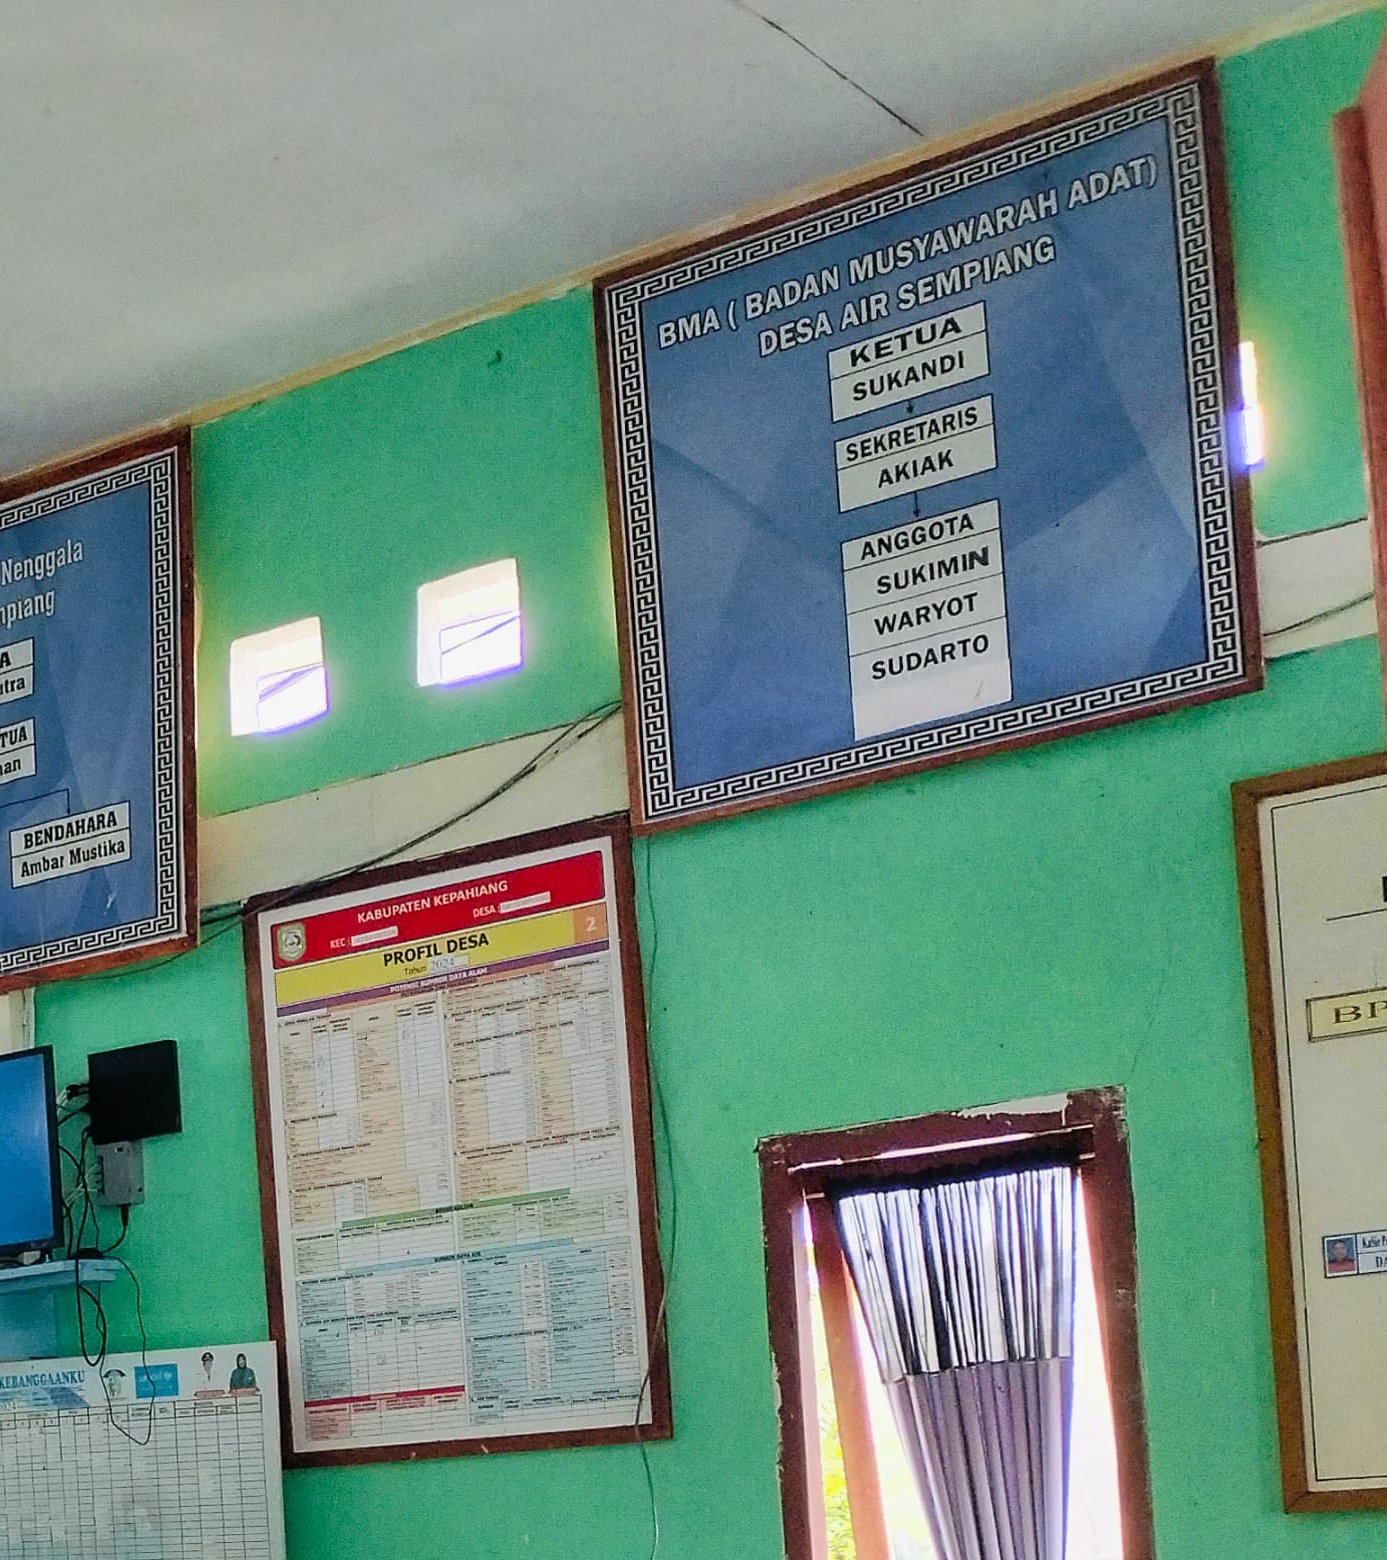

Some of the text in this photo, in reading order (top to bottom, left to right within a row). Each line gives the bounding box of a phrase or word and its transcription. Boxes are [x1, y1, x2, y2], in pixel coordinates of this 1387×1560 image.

[658, 307, 721, 349] BMA
[744, 265, 840, 320] BADAN
[848, 189, 1058, 285] MUSYAWARAH
[1067, 154, 1157, 208] ADAT)
[758, 235, 1055, 357] DESA AIR SEMPIANG
[850, 317, 962, 367] KETUA
[853, 351, 964, 401] SUKANDI
[846, 406, 978, 462] SEKRETARIS
[878, 449, 955, 488] AKIAK
[860, 513, 974, 560] ANGGOTA
[1, 538, 84, 585] Nenggala
[877, 547, 989, 594] SUKIMIN
[874, 593, 978, 635] WARYOT
[872, 634, 989, 680] SUDARTO
[24, 811, 117, 849] BENDAHARA
[21, 840, 125, 878] Ambar Mustika
[358, 880, 508, 923] KABUPATEN KEPAHIANG
[473, 906, 495, 918] DESA
[330, 938, 346, 949] KEC
[586, 916, 597, 932] 2
[384, 933, 489, 967] PROFIL DESA
[404, 966, 427, 976] Tahun
